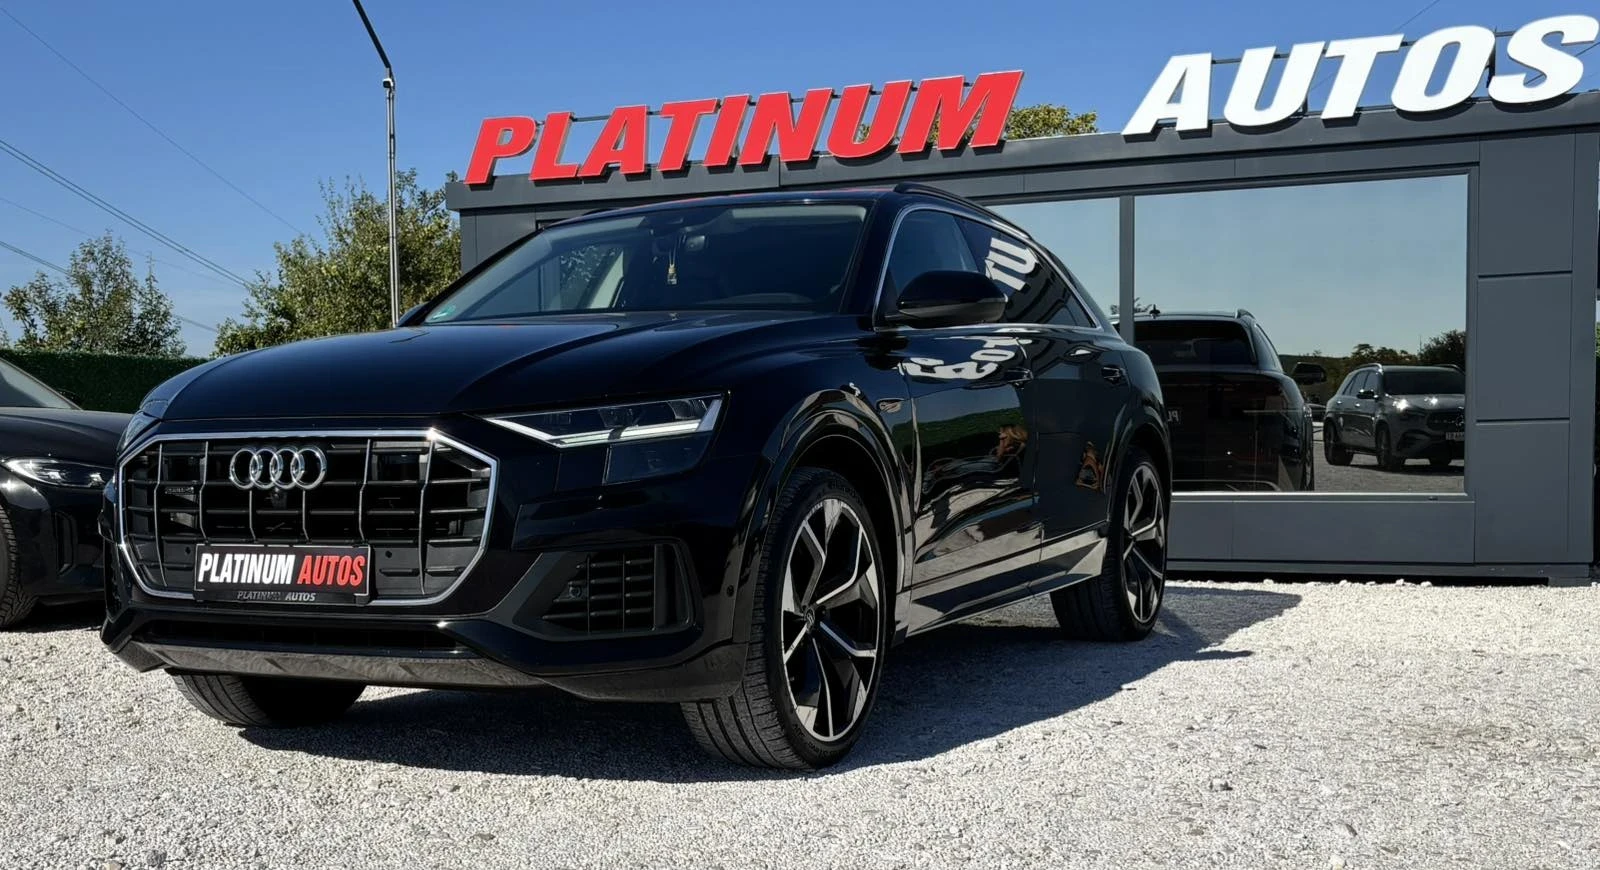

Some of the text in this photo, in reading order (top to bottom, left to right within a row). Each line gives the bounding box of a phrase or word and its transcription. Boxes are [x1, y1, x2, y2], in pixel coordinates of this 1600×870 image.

[464, 14, 1600, 185] PLATINUM AUTOS
[197, 552, 366, 587] PLATINUM AUTOS
[284, 591, 317, 602] AUTOS
